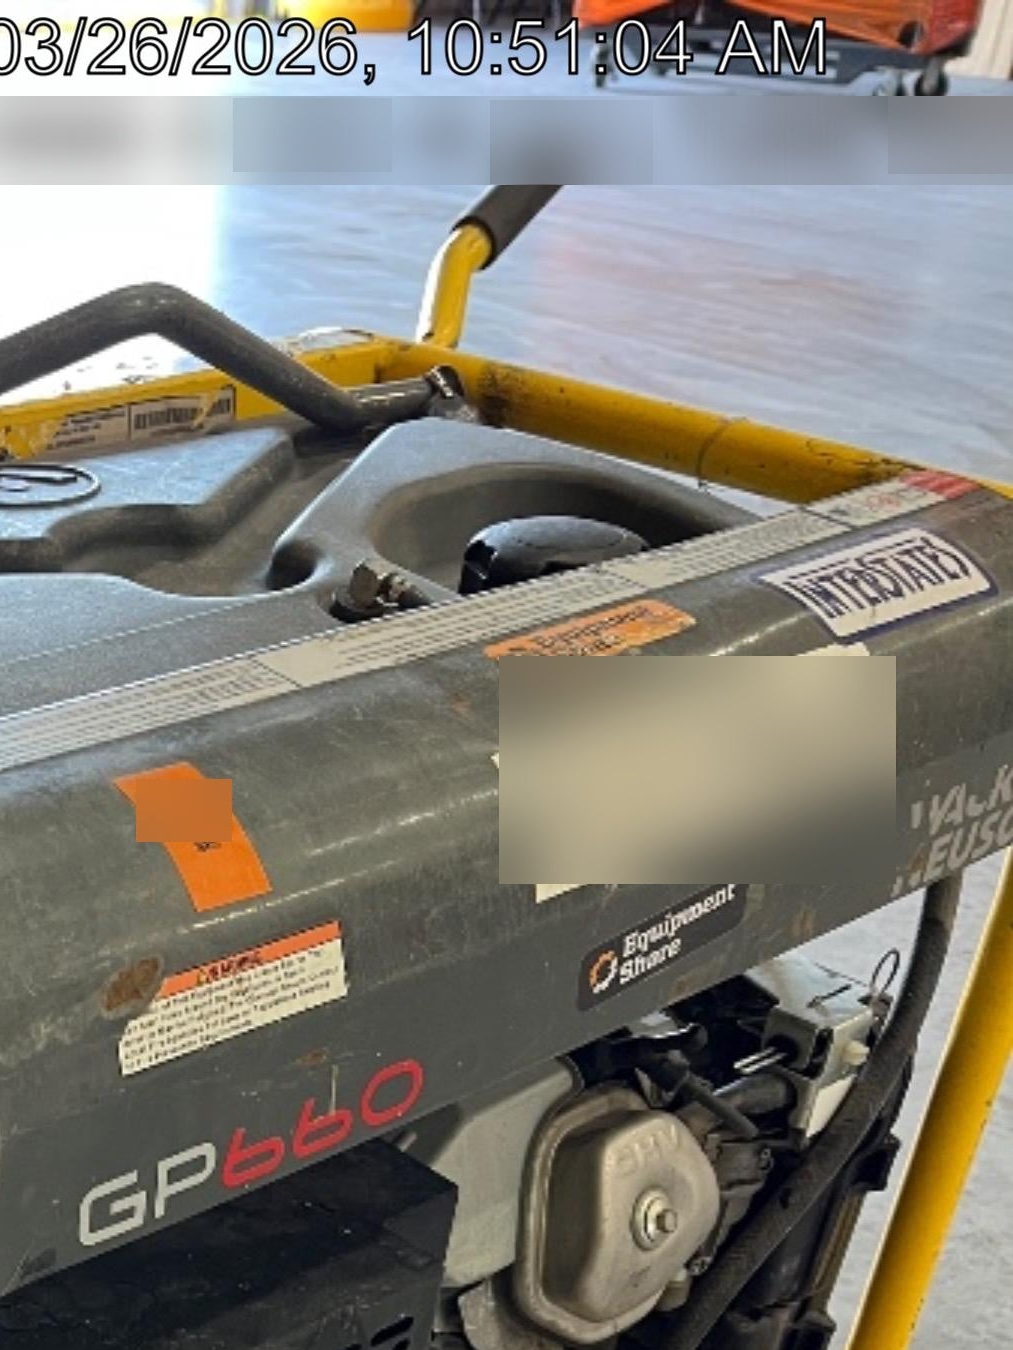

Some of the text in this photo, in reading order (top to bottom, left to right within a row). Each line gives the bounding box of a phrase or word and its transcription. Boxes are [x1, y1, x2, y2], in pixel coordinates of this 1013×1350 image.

[623, 884, 736, 958] Equipment
[620, 938, 682, 985] Share
[79, 1059, 424, 1247] GP660
